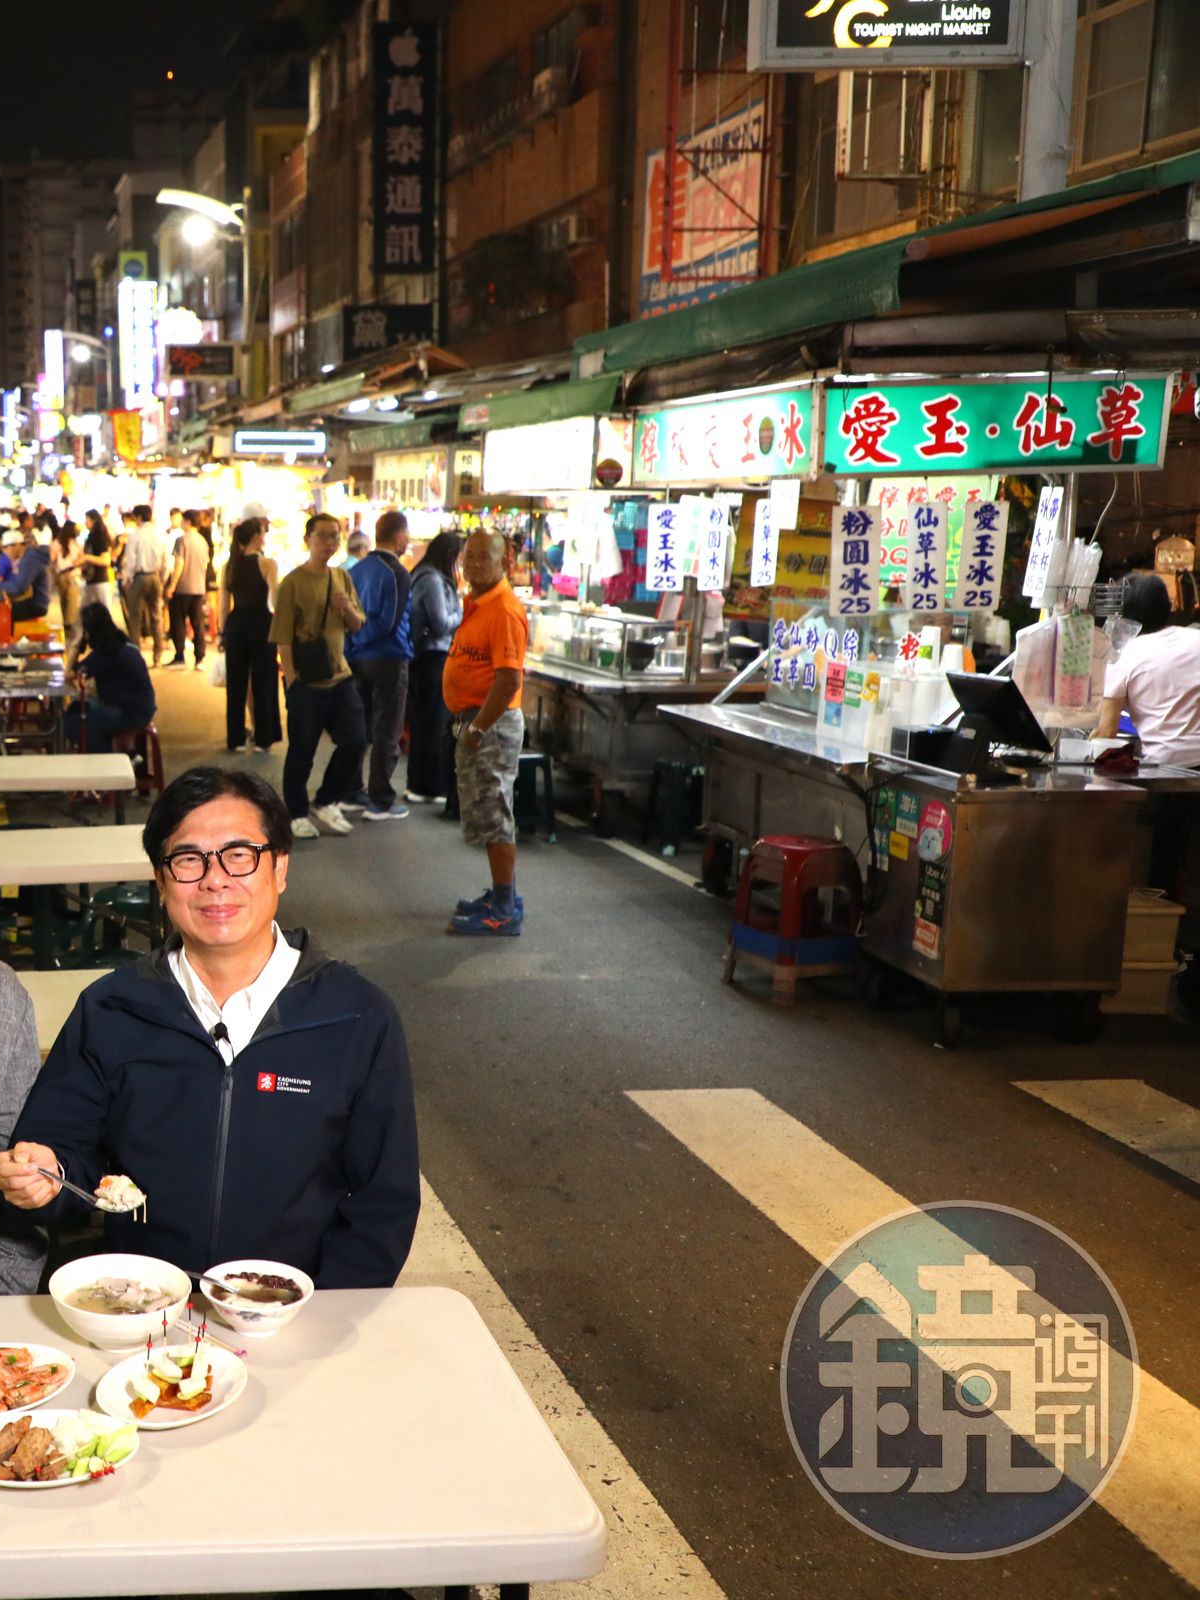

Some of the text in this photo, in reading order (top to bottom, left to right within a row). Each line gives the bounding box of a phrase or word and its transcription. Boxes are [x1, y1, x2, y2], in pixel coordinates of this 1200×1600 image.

[942, 6, 991, 21] Liouhe
[853, 22, 991, 37] TOURIST NIGHT MARKET
[385, 74, 424, 264] 萬泰通訊
[653, 509, 677, 589] 愛玉冰 25
[963, 504, 1000, 608] 愛玉冰 25
[839, 510, 874, 615] 粉圓冰 25
[911, 507, 939, 610] 仙草冰 25
[704, 575, 720, 587] 25
[757, 571, 772, 584] 25
[277, 1076, 311, 1086] KAOHSIUNG
[277, 1086, 311, 1094] GOVERNMENT
